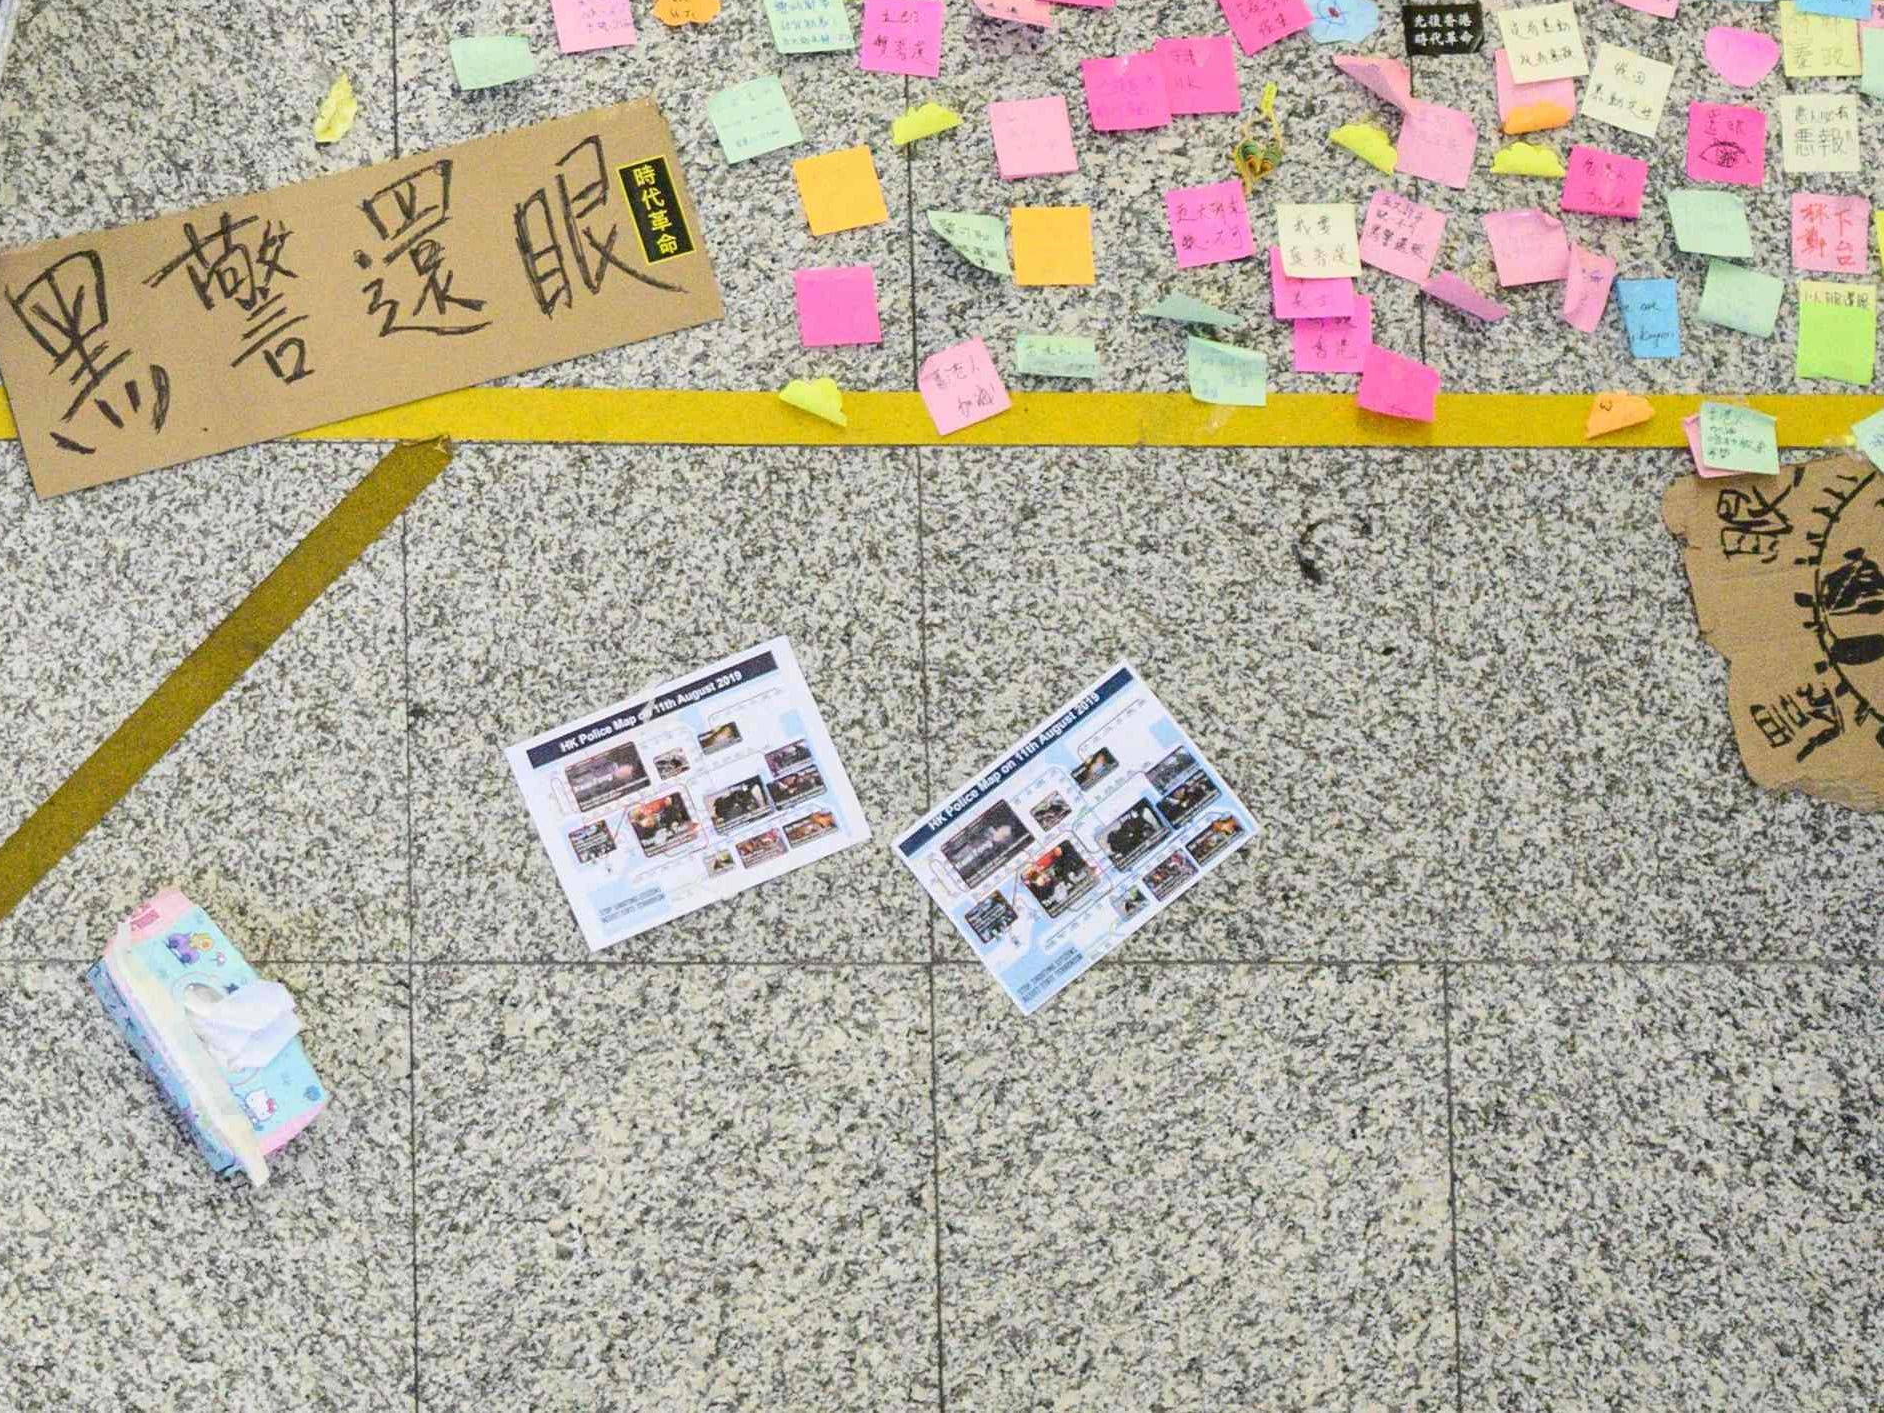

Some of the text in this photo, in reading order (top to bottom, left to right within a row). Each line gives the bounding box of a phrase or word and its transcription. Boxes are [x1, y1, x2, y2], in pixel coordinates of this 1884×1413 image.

[1413, 13, 1472, 28] 光復香港
[1413, 31, 1474, 47] 時代革命
[633, 164, 680, 256] 時代革命
[4, 134, 690, 456] 黑警還眼
[560, 738, 579, 753] HK
[578, 724, 613, 745] Police
[613, 715, 637, 732] Map
[654, 697, 677, 714] 11th
[677, 683, 717, 704] August
[716, 670, 743, 690] 2019
[928, 692, 1101, 831] HK Police Map on 11th August 2019
